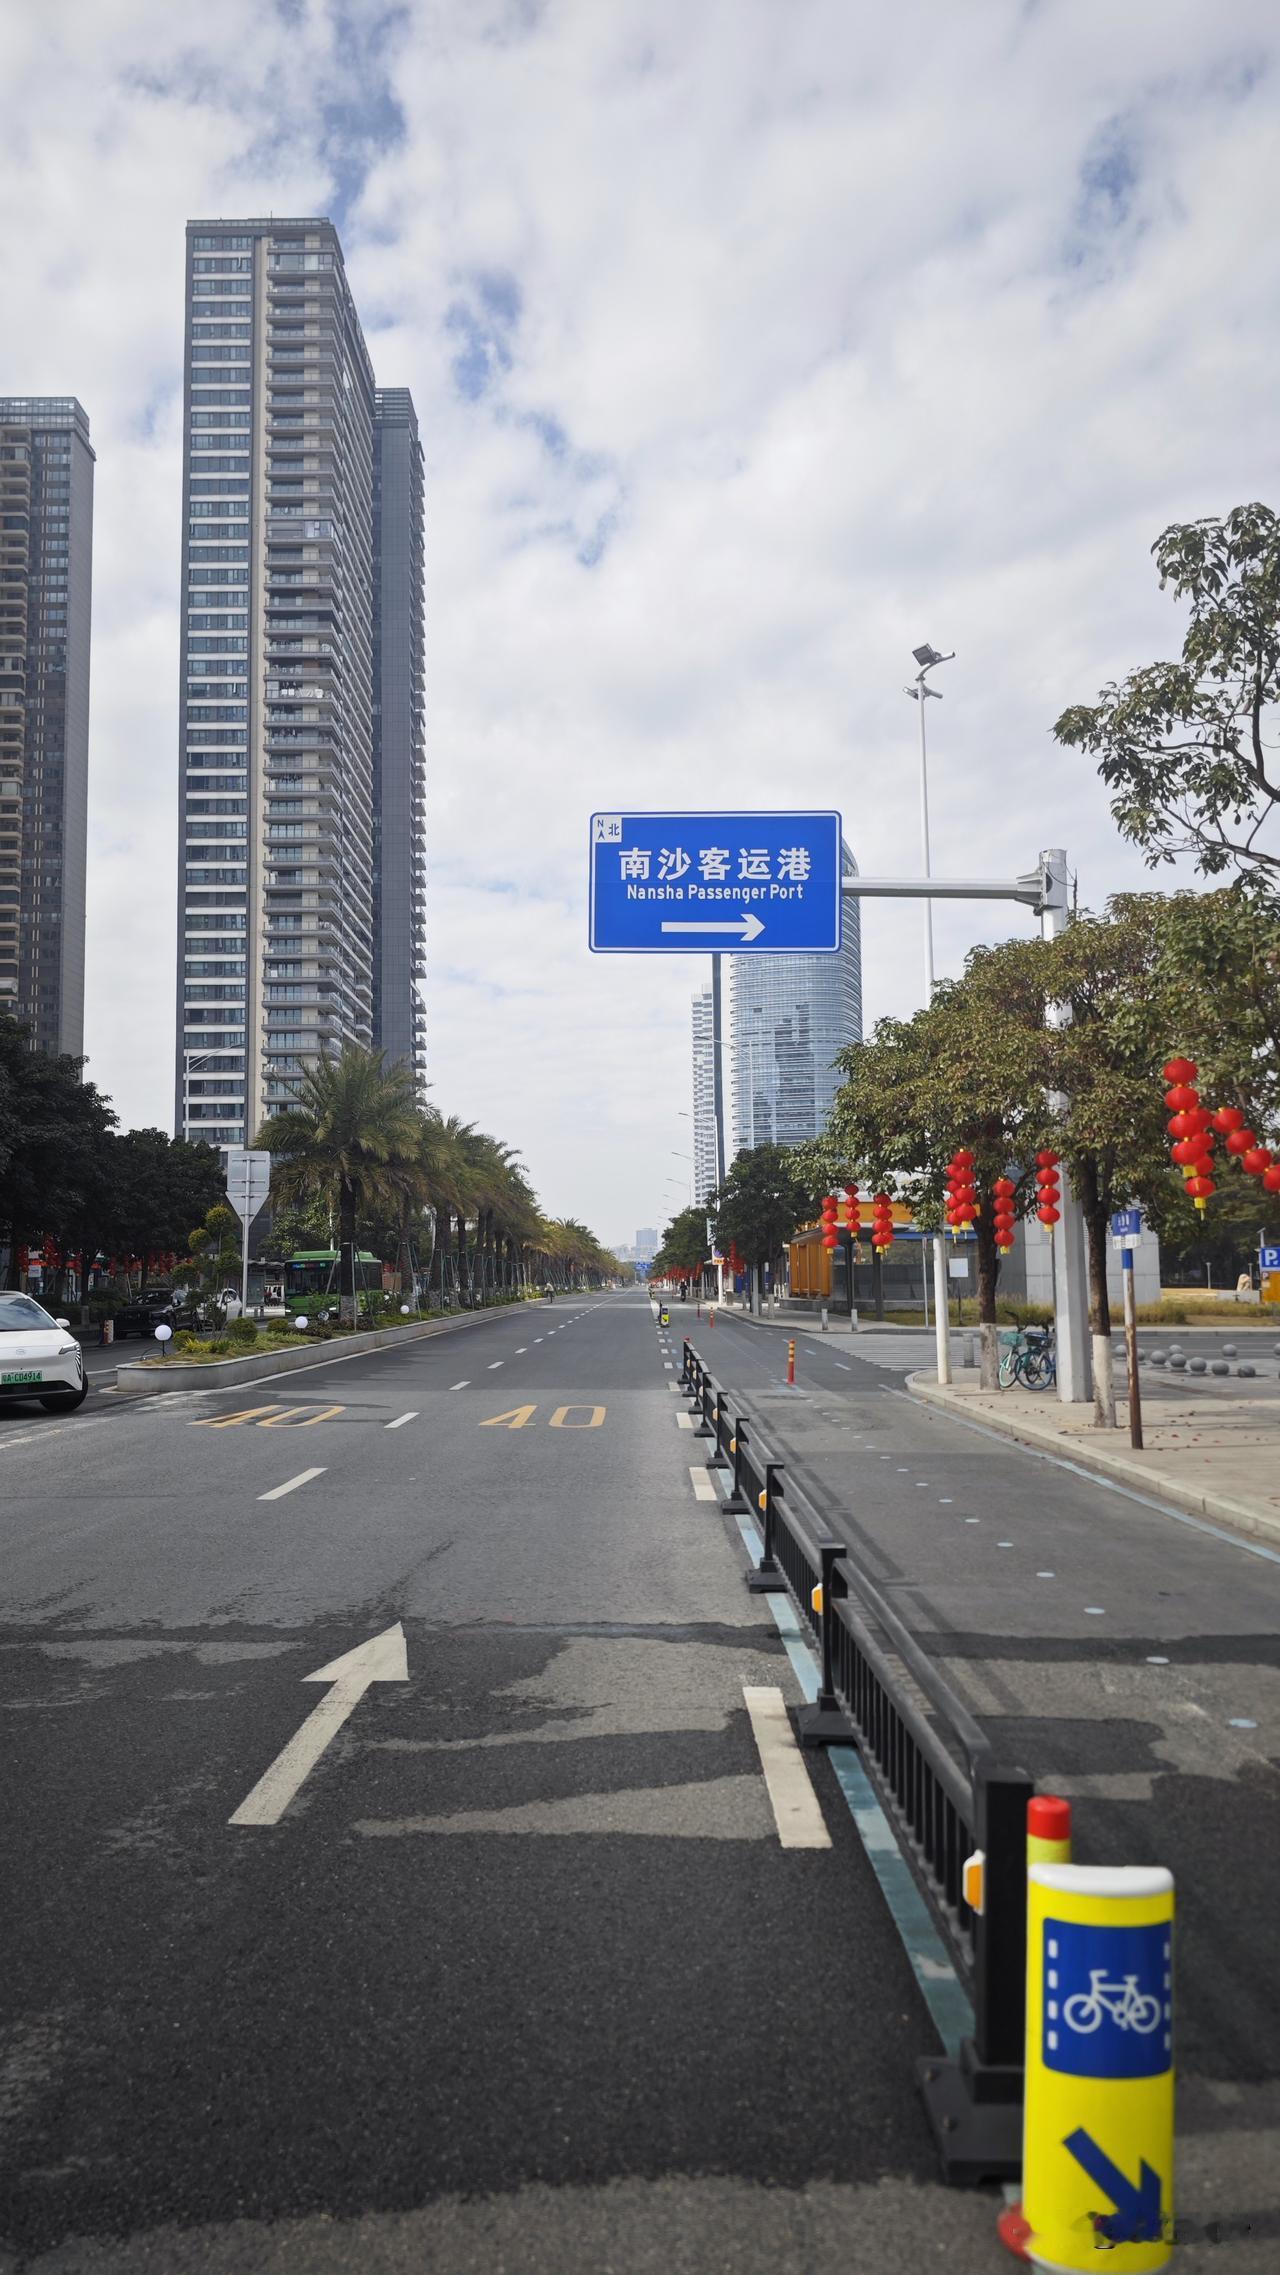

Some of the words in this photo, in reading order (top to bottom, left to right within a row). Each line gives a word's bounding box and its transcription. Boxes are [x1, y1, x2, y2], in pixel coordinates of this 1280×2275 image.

[597, 819, 604, 828] N
[608, 823, 620, 836] 北
[618, 847, 811, 881] 南沙客运港
[627, 884, 684, 900] Nansha
[688, 884, 767, 904] Passenger
[770, 884, 803, 900] Port
[1264, 1249, 1278, 1266] P
[187, 1405, 347, 1428] 40
[478, 1405, 607, 1428] 40
